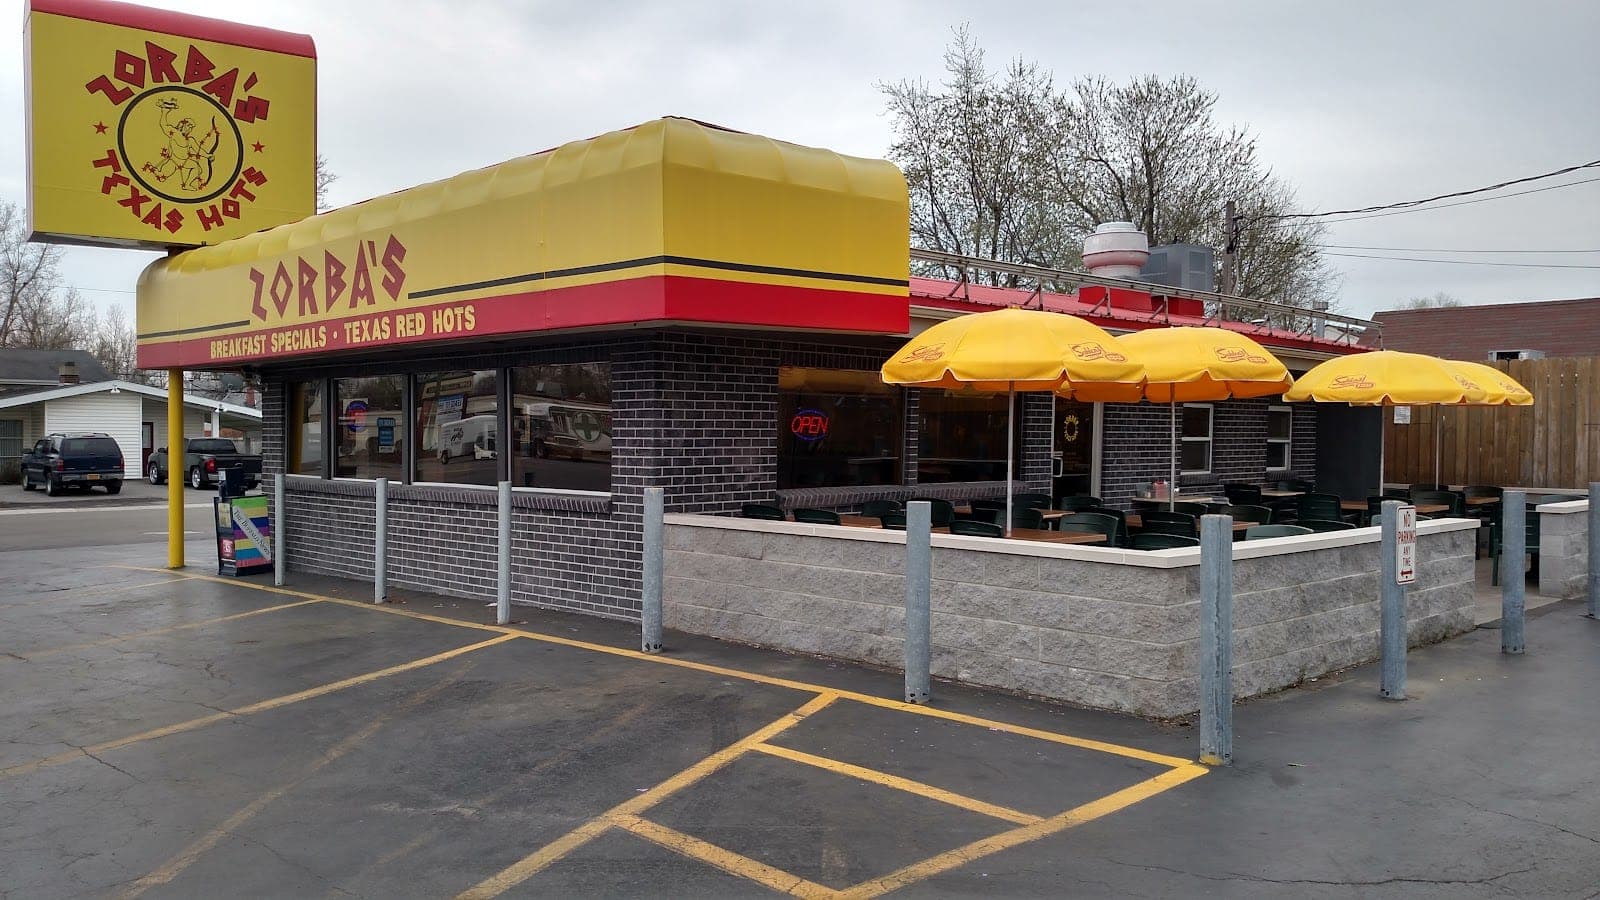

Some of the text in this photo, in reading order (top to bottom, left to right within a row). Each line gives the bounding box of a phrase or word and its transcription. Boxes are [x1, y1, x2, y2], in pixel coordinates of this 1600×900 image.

[85, 40, 270, 124] ZORBA'S
[92, 149, 268, 234] TEXAS HOTS
[249, 233, 407, 322] ZORBA'S
[210, 304, 476, 359] BREAKFAST SPECIALS TEXAS RED HOTS
[791, 416, 829, 434] OPEN
[1397, 530, 1416, 545] PARKING
[1403, 513, 1411, 528] NO
[1403, 546, 1411, 556] ANY
